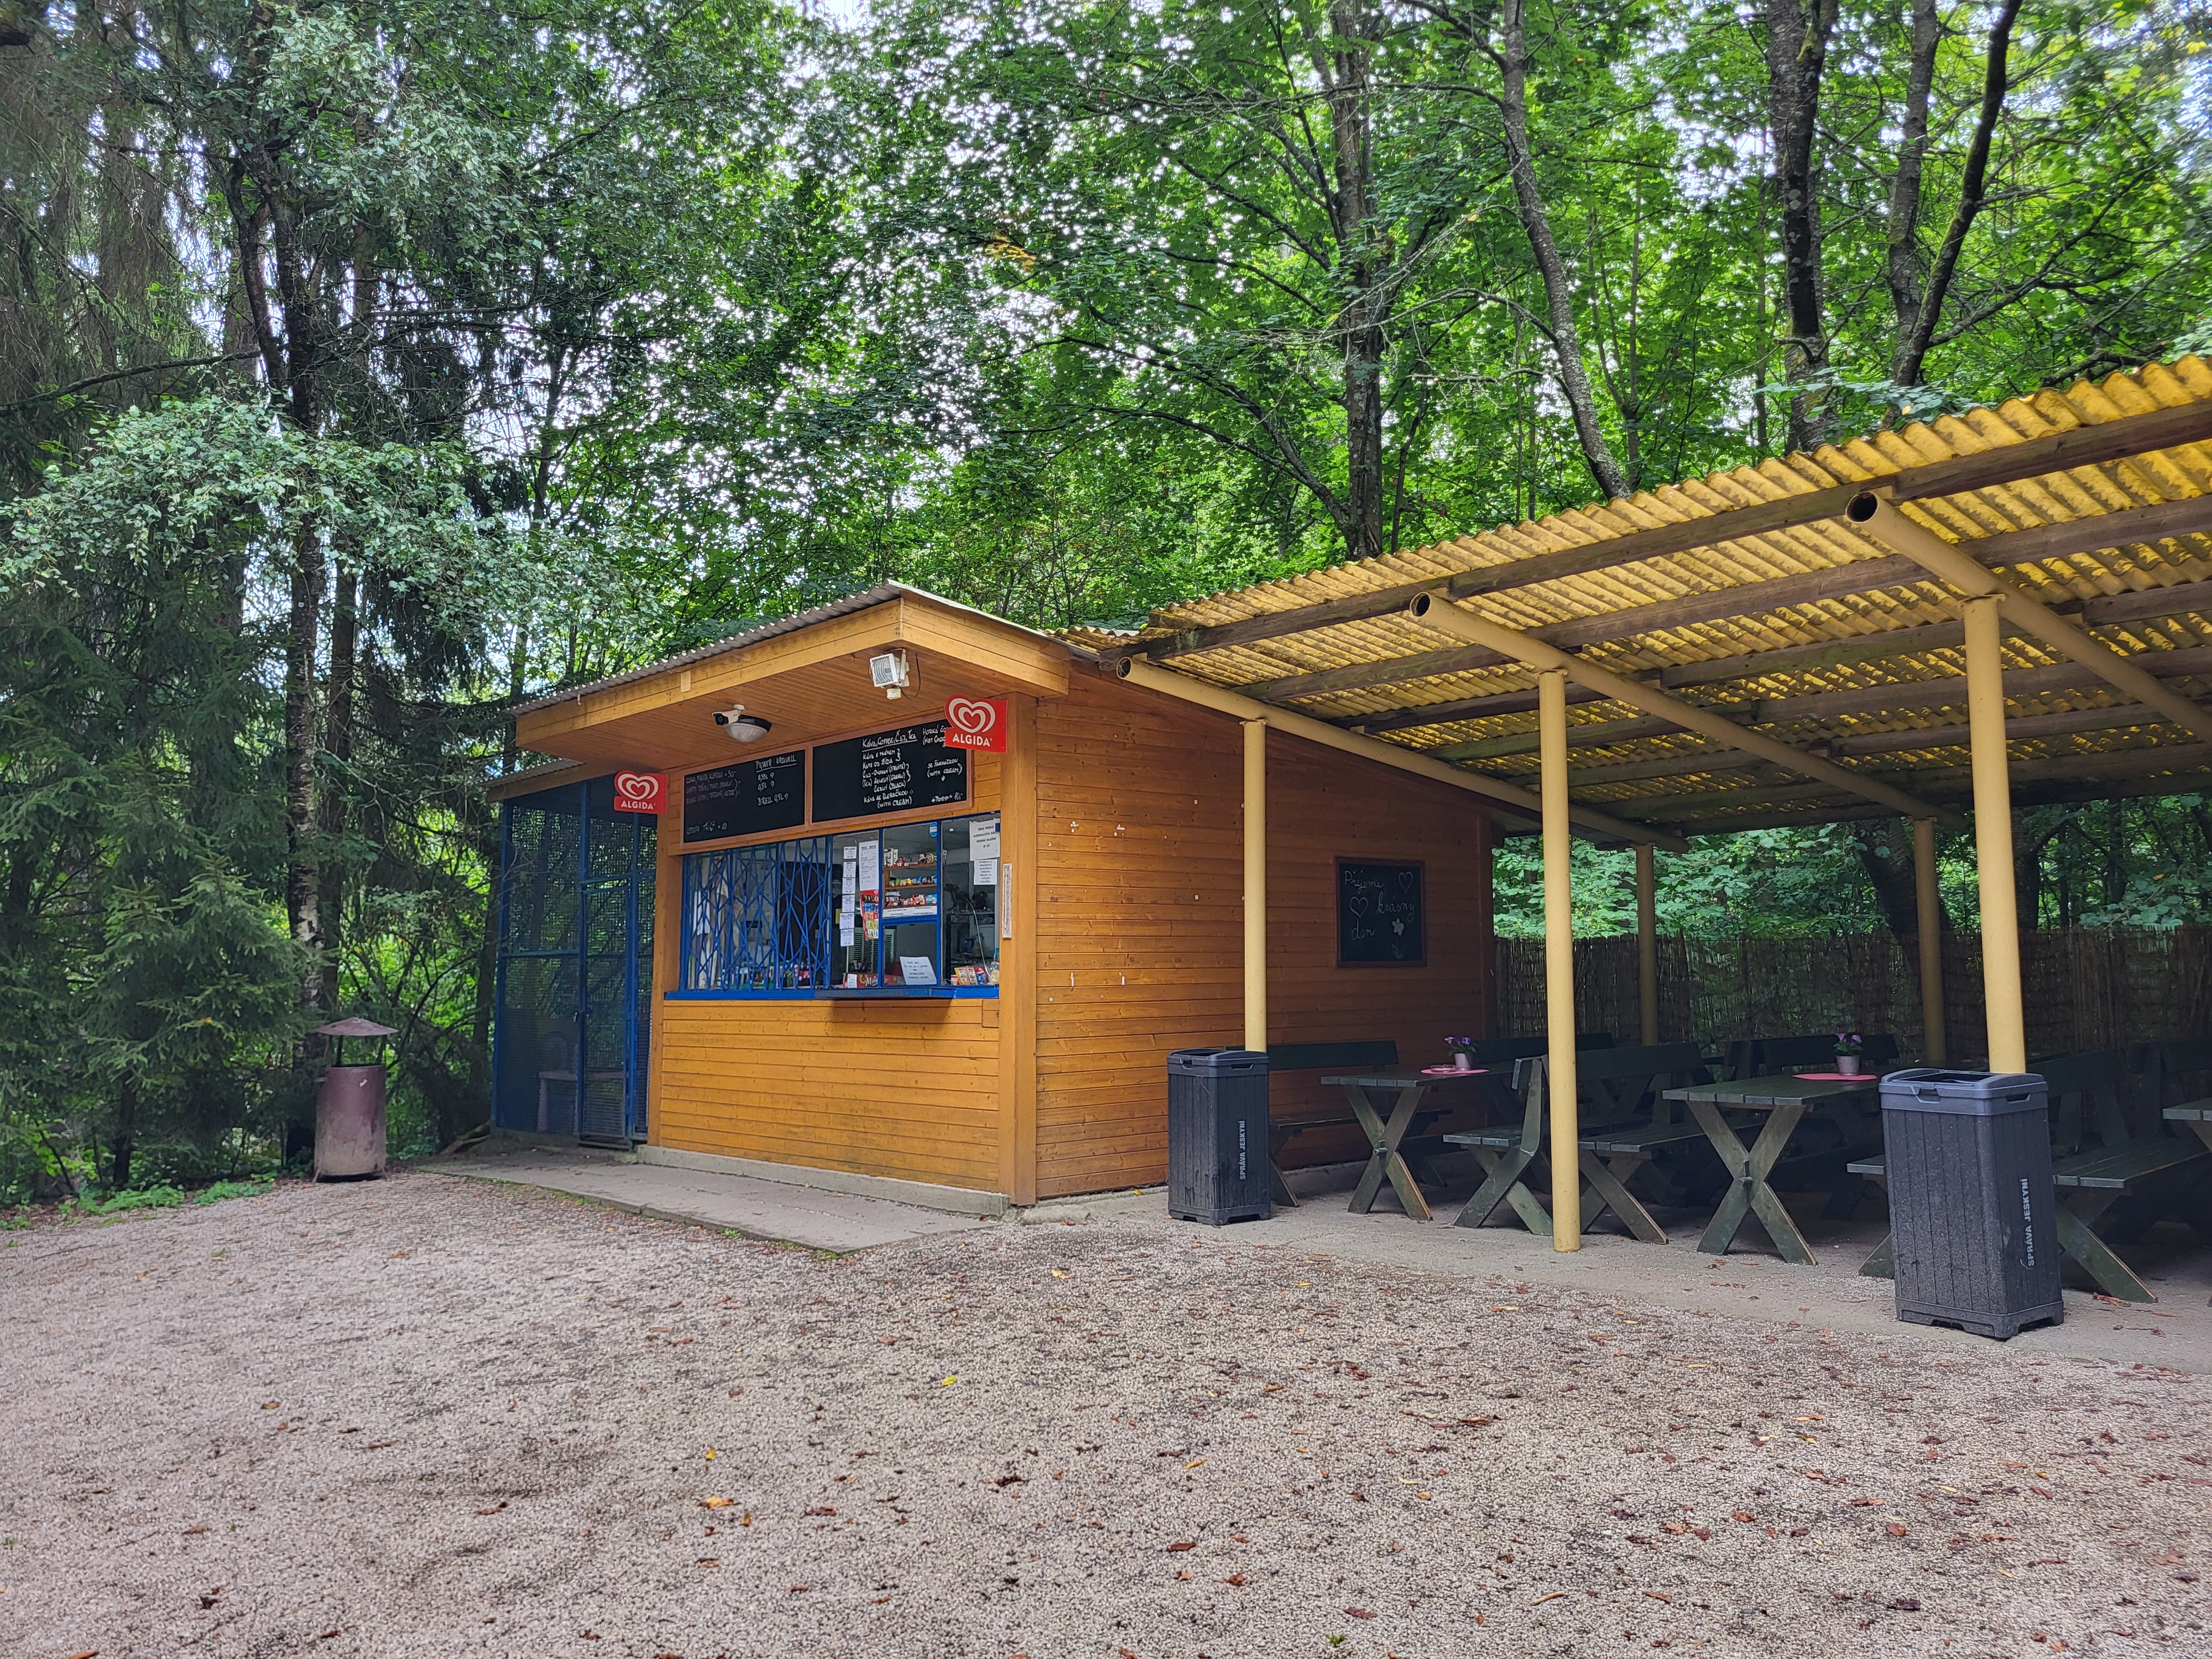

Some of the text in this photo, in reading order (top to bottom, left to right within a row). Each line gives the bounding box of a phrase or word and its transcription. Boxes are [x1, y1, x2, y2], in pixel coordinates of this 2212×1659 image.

[952, 733, 990, 747] ALGIDA
[620, 800, 654, 810] ALGIDA
[1344, 870, 1385, 894] Přejeme
[1376, 891, 1415, 922] krásný
[1352, 919, 1375, 940] den
[2020, 1178, 2034, 1266] SPRÁVA JESKYNÍ
